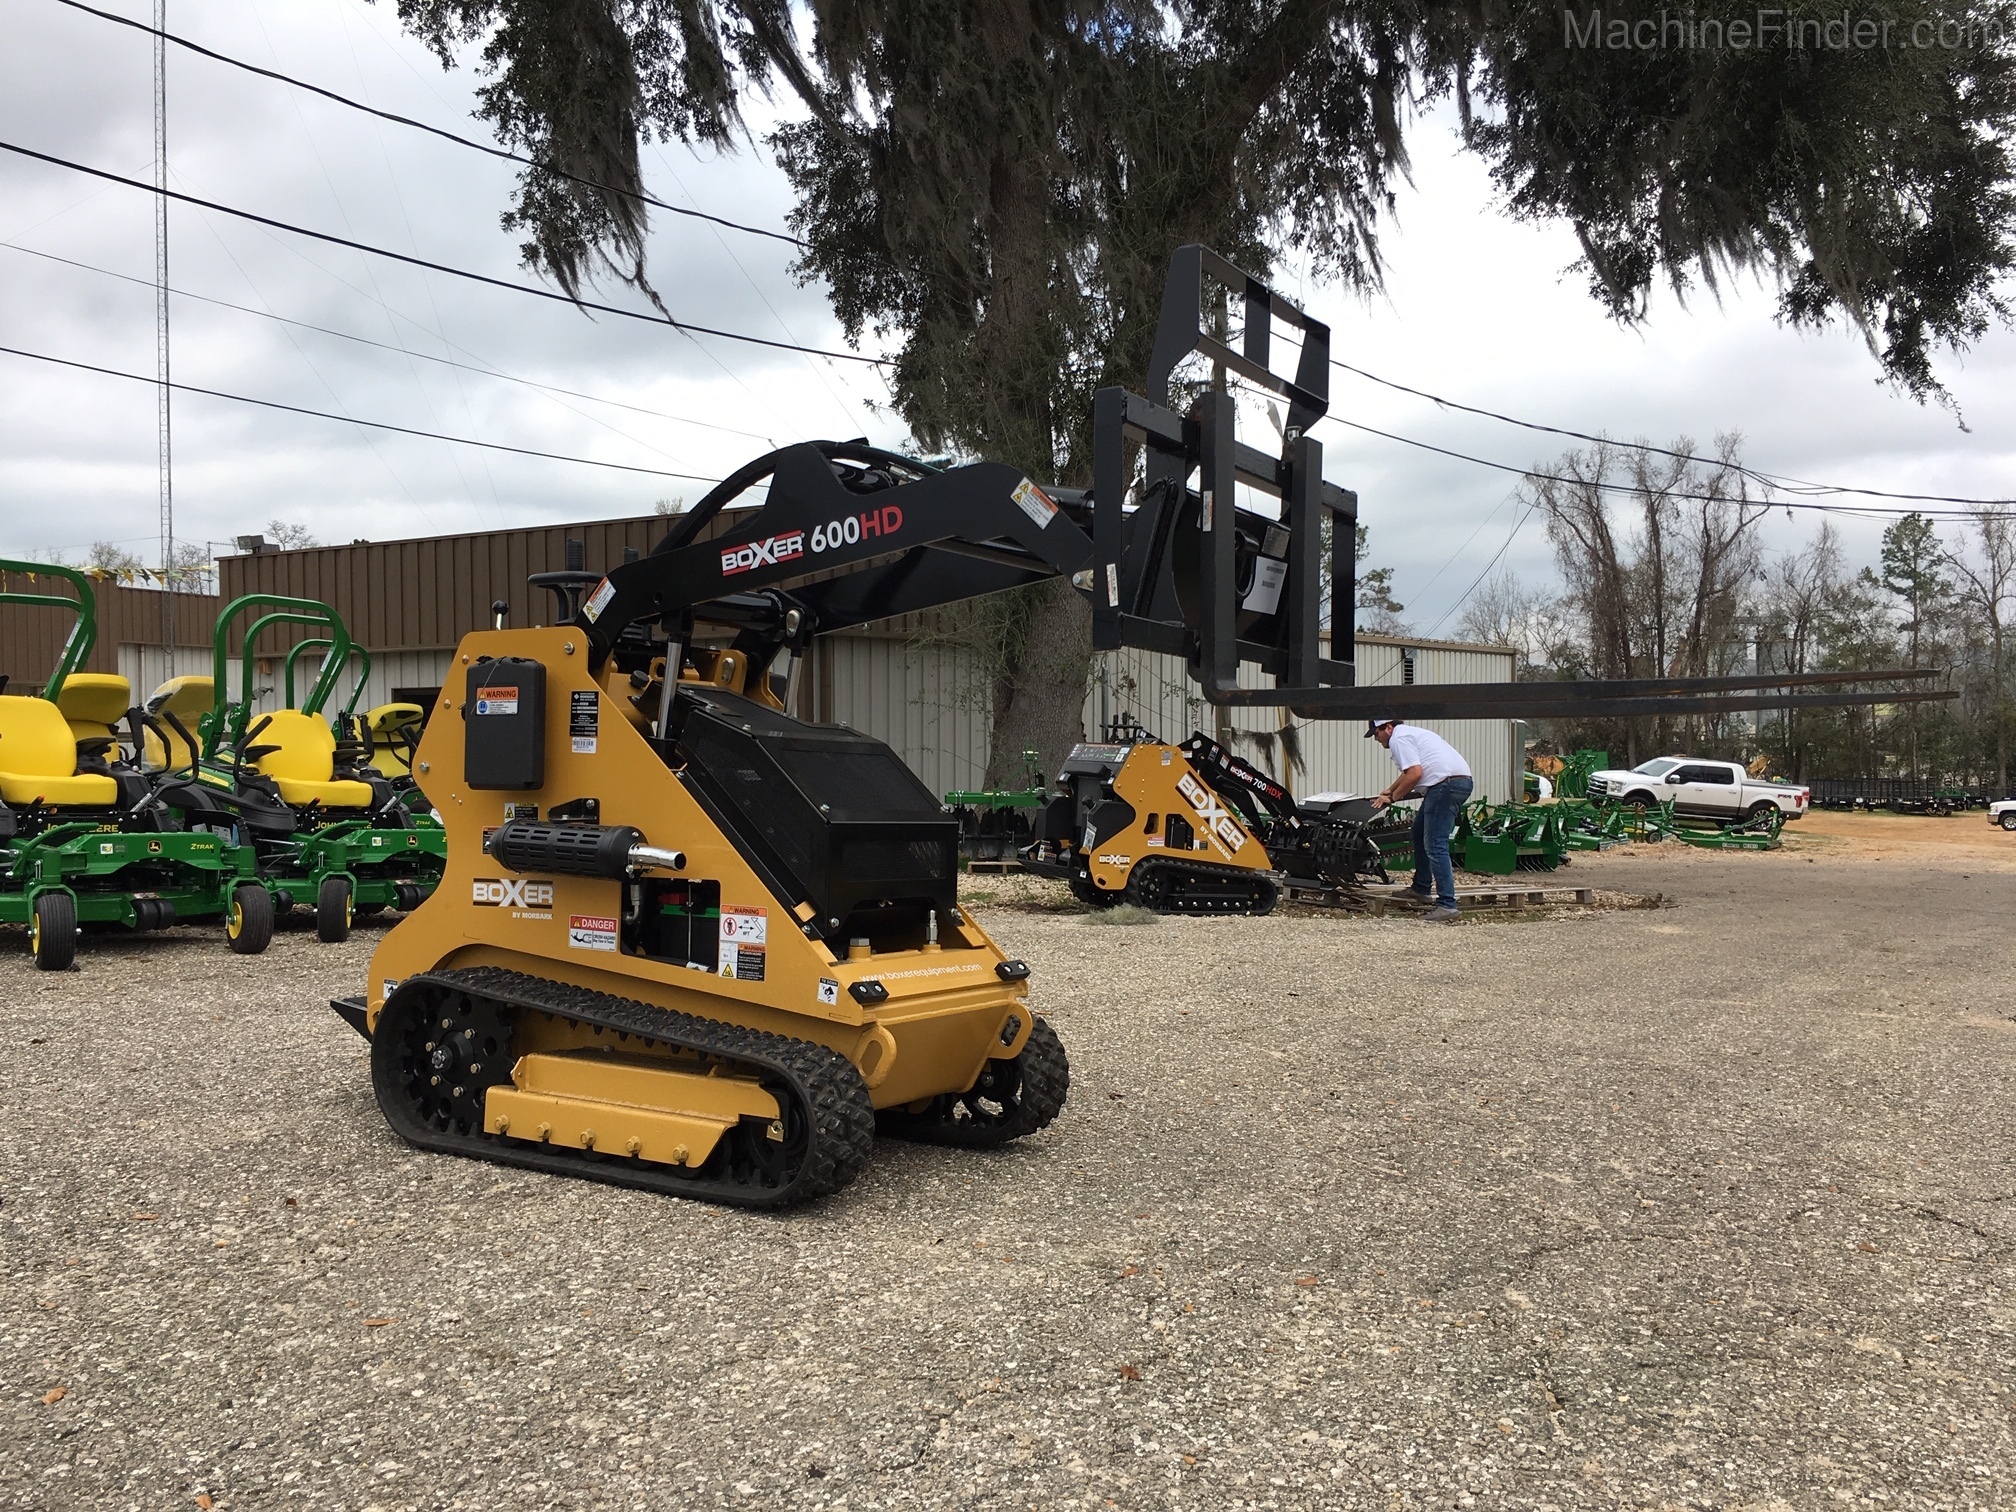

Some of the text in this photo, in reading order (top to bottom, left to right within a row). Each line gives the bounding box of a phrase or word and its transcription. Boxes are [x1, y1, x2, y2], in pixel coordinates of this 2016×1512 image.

[721, 537, 804, 570] BOXER
[486, 690, 517, 698] WARNING
[1229, 765, 1254, 783] BOXER
[1177, 773, 1245, 851] BOXER
[1207, 833, 1233, 861] MORBARK
[1099, 854, 1131, 865] BOXER
[473, 878, 554, 909] BOXER
[512, 911, 553, 920] BY MORBARK
[734, 907, 760, 916] WARNING
[581, 918, 615, 930] DANGER
[859, 962, 983, 982] www.boxerequipment.com
